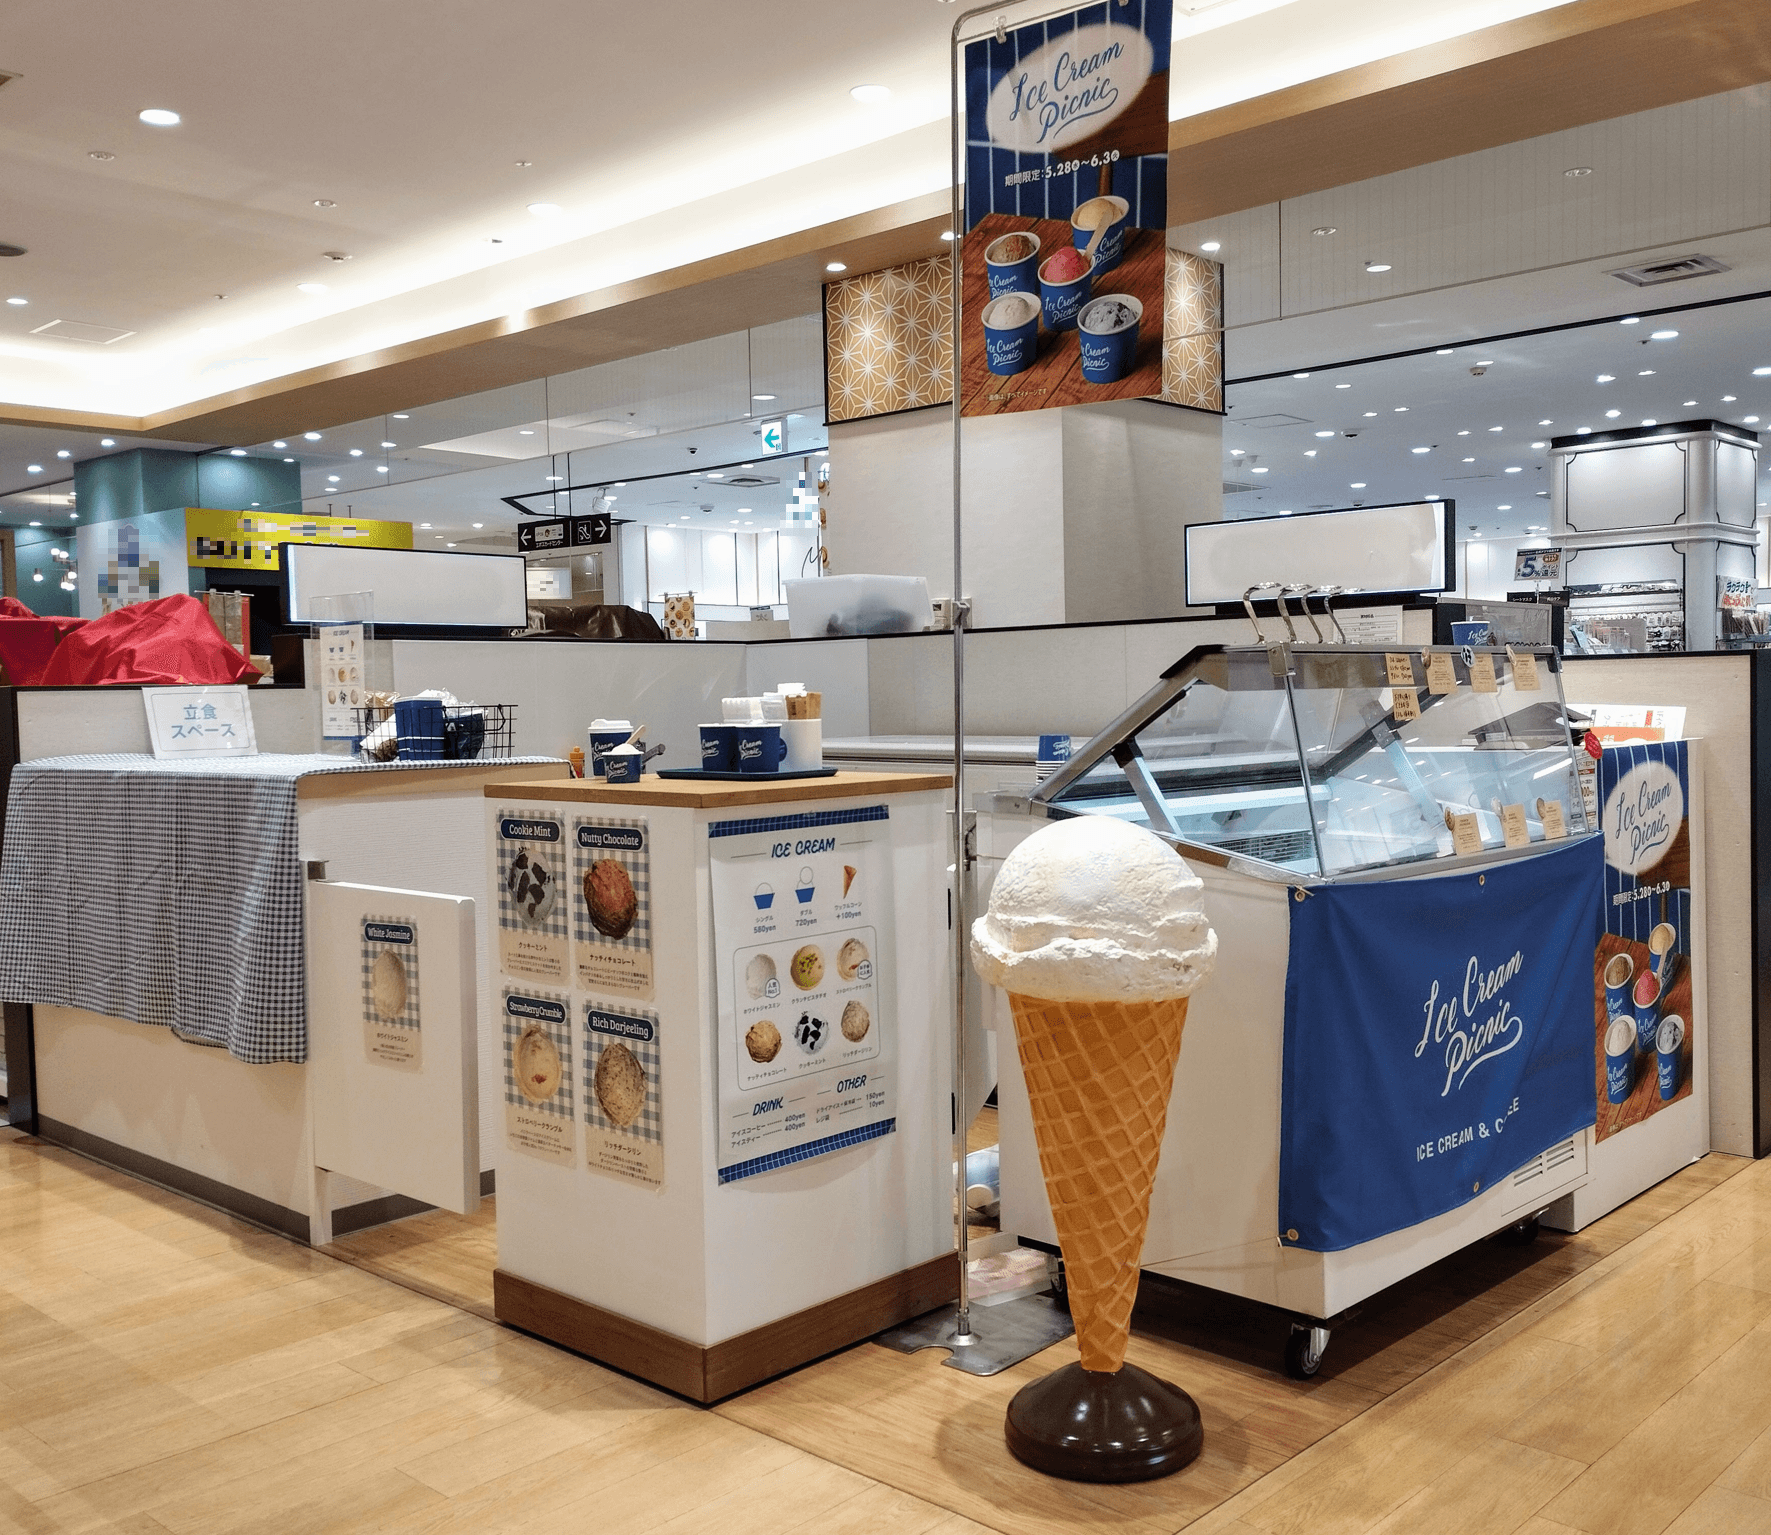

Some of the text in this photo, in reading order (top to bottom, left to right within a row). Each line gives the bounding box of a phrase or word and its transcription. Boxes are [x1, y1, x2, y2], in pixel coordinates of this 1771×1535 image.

[1009, 41, 1125, 122] Ice Cream
[1036, 77, 1119, 144] Picnic
[1100, 230, 1123, 252] Cream
[994, 274, 1018, 288] Cream
[1045, 291, 1082, 311] Ice Cream
[1052, 303, 1081, 323] Picnic
[996, 338, 1024, 353] Cream
[1085, 343, 1111, 357] Cream
[993, 349, 1022, 366] Picnic
[1083, 355, 1110, 371] Picnic
[183, 703, 218, 720] 立食
[171, 723, 236, 739] スペース
[742, 739, 762, 749] Cream
[1615, 792, 1636, 840] Ice
[1638, 780, 1672, 818] Cream
[509, 824, 551, 837] Cookie Mint
[1629, 810, 1670, 865] Picnic
[581, 833, 639, 846] Nutty Chocolate
[771, 837, 836, 858] ICE CREAM
[755, 915, 774, 923] シングル
[795, 918, 817, 927] 720yen
[367, 926, 410, 940] White Jasmine
[518, 942, 547, 952] クッキーミント
[590, 954, 636, 966] ナッティチョコレート
[509, 1001, 562, 1019] Strawberry Crumble
[1414, 950, 1524, 1058] Ice Cream
[592, 1016, 649, 1039] Rich Darjeeling
[1441, 999, 1523, 1097] Picnic
[798, 1058, 826, 1069] クッキーミント
[747, 1067, 787, 1081] ナッティチョコレート
[836, 1074, 867, 1093] OTHER
[866, 1091, 885, 1101] 150yen
[869, 1100, 885, 1108] 10yen
[752, 1096, 784, 1116] DRINK
[731, 1112, 806, 1138] アイスコーヒー 400yen
[731, 1121, 806, 1148] アイスティー 400yen
[1416, 1141, 1435, 1162] ICE
[1438, 1126, 1474, 1154] CREAM
[1478, 1122, 1491, 1139] &
